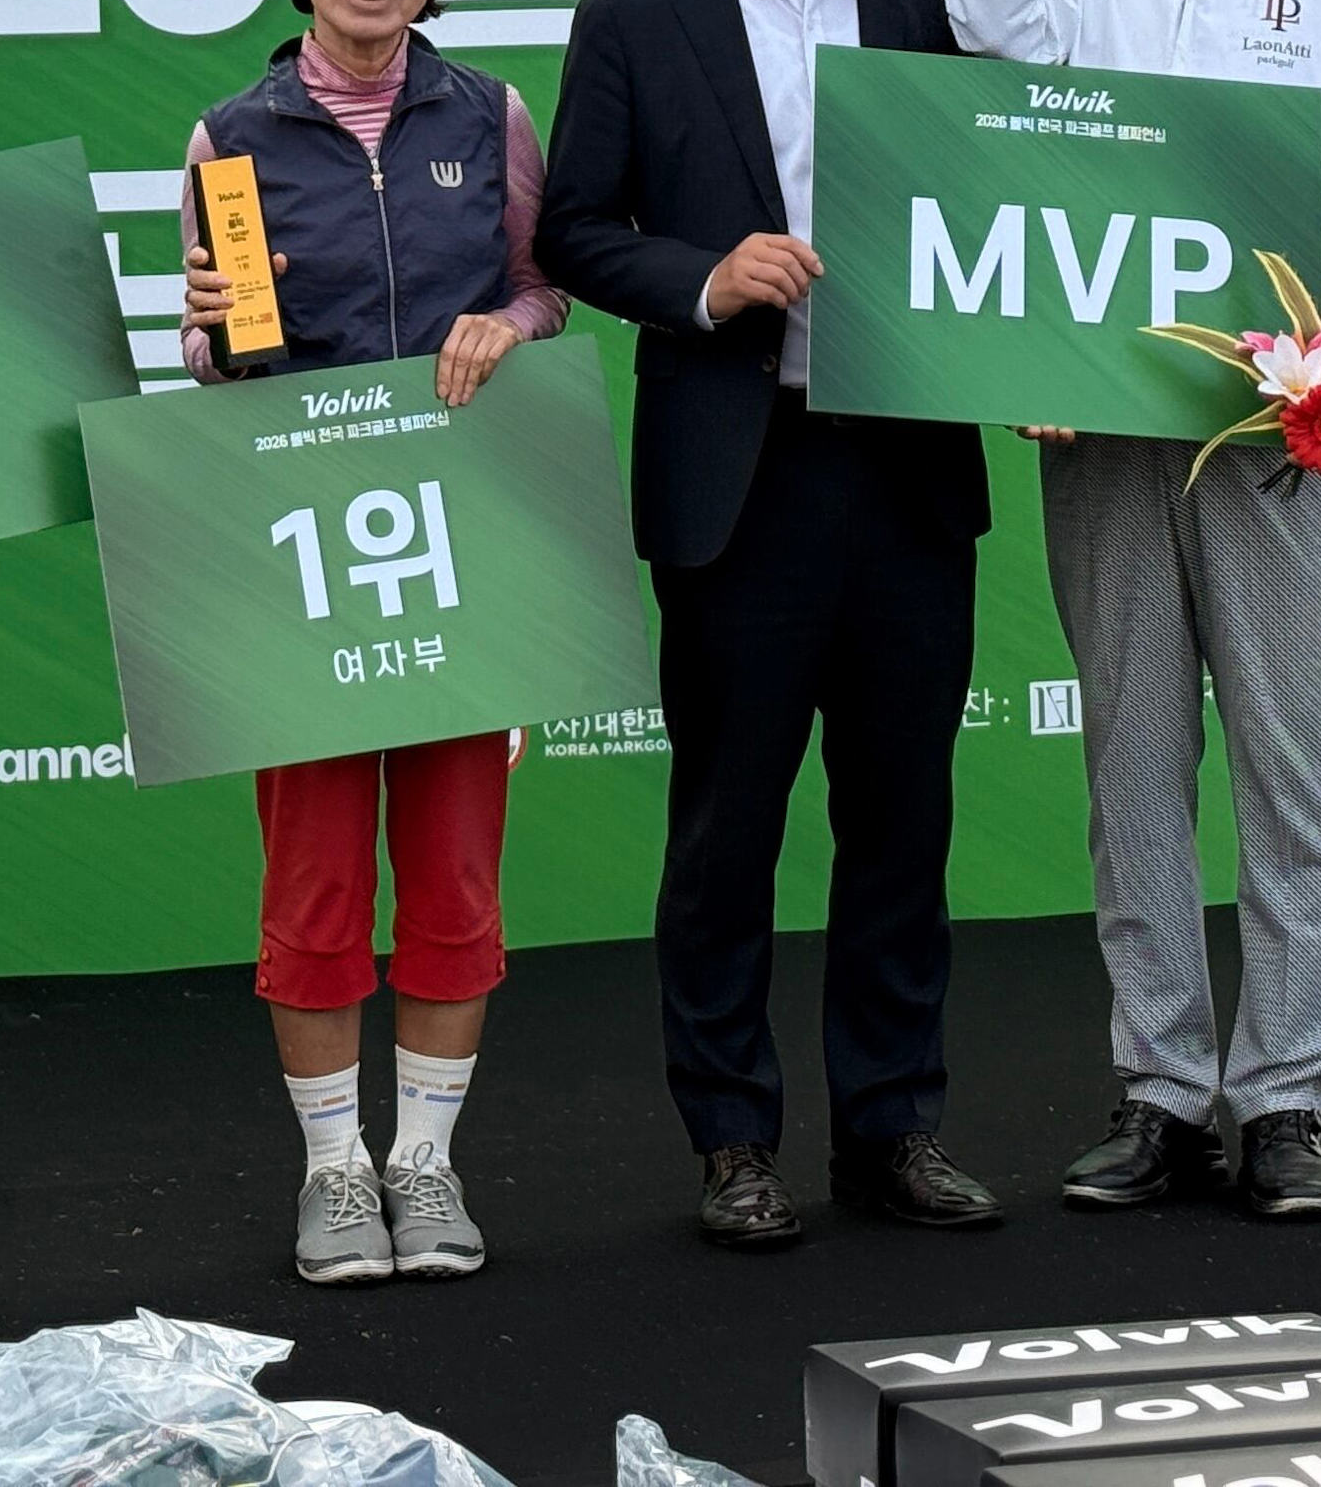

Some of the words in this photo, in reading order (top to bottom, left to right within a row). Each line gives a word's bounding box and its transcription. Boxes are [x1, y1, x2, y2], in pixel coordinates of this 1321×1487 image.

[1026, 84, 1115, 114] Volvik
[975, 113, 1007, 129] 2026
[1037, 117, 1062, 134] 전국
[1065, 120, 1114, 138] 파크골프
[909, 196, 1233, 328] MVP
[301, 384, 393, 419] Volvik
[255, 434, 288, 451] 2026
[318, 424, 345, 443] 전국
[347, 419, 398, 439] 파크골프
[270, 480, 460, 620] 1위
[332, 634, 447, 684] 여자부
[544, 742, 600, 757] KOREA
[603, 738, 672, 754] PARKGO
